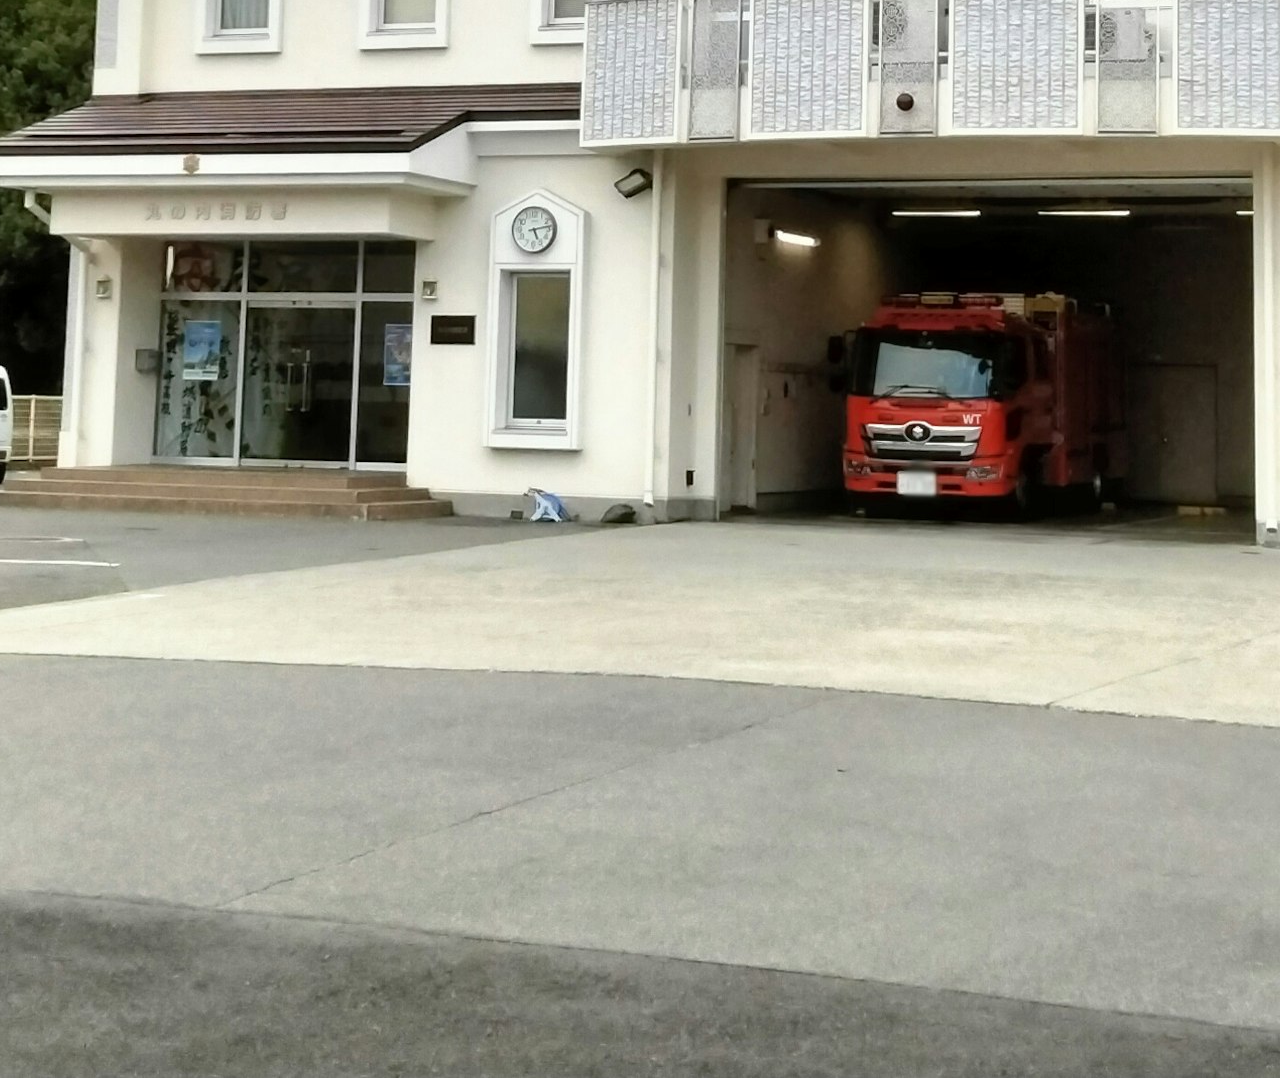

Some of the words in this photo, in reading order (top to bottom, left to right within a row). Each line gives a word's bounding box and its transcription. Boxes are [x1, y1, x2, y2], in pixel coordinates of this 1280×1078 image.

[145, 201, 288, 221] 丸の内消防署
[962, 413, 982, 425] WT
